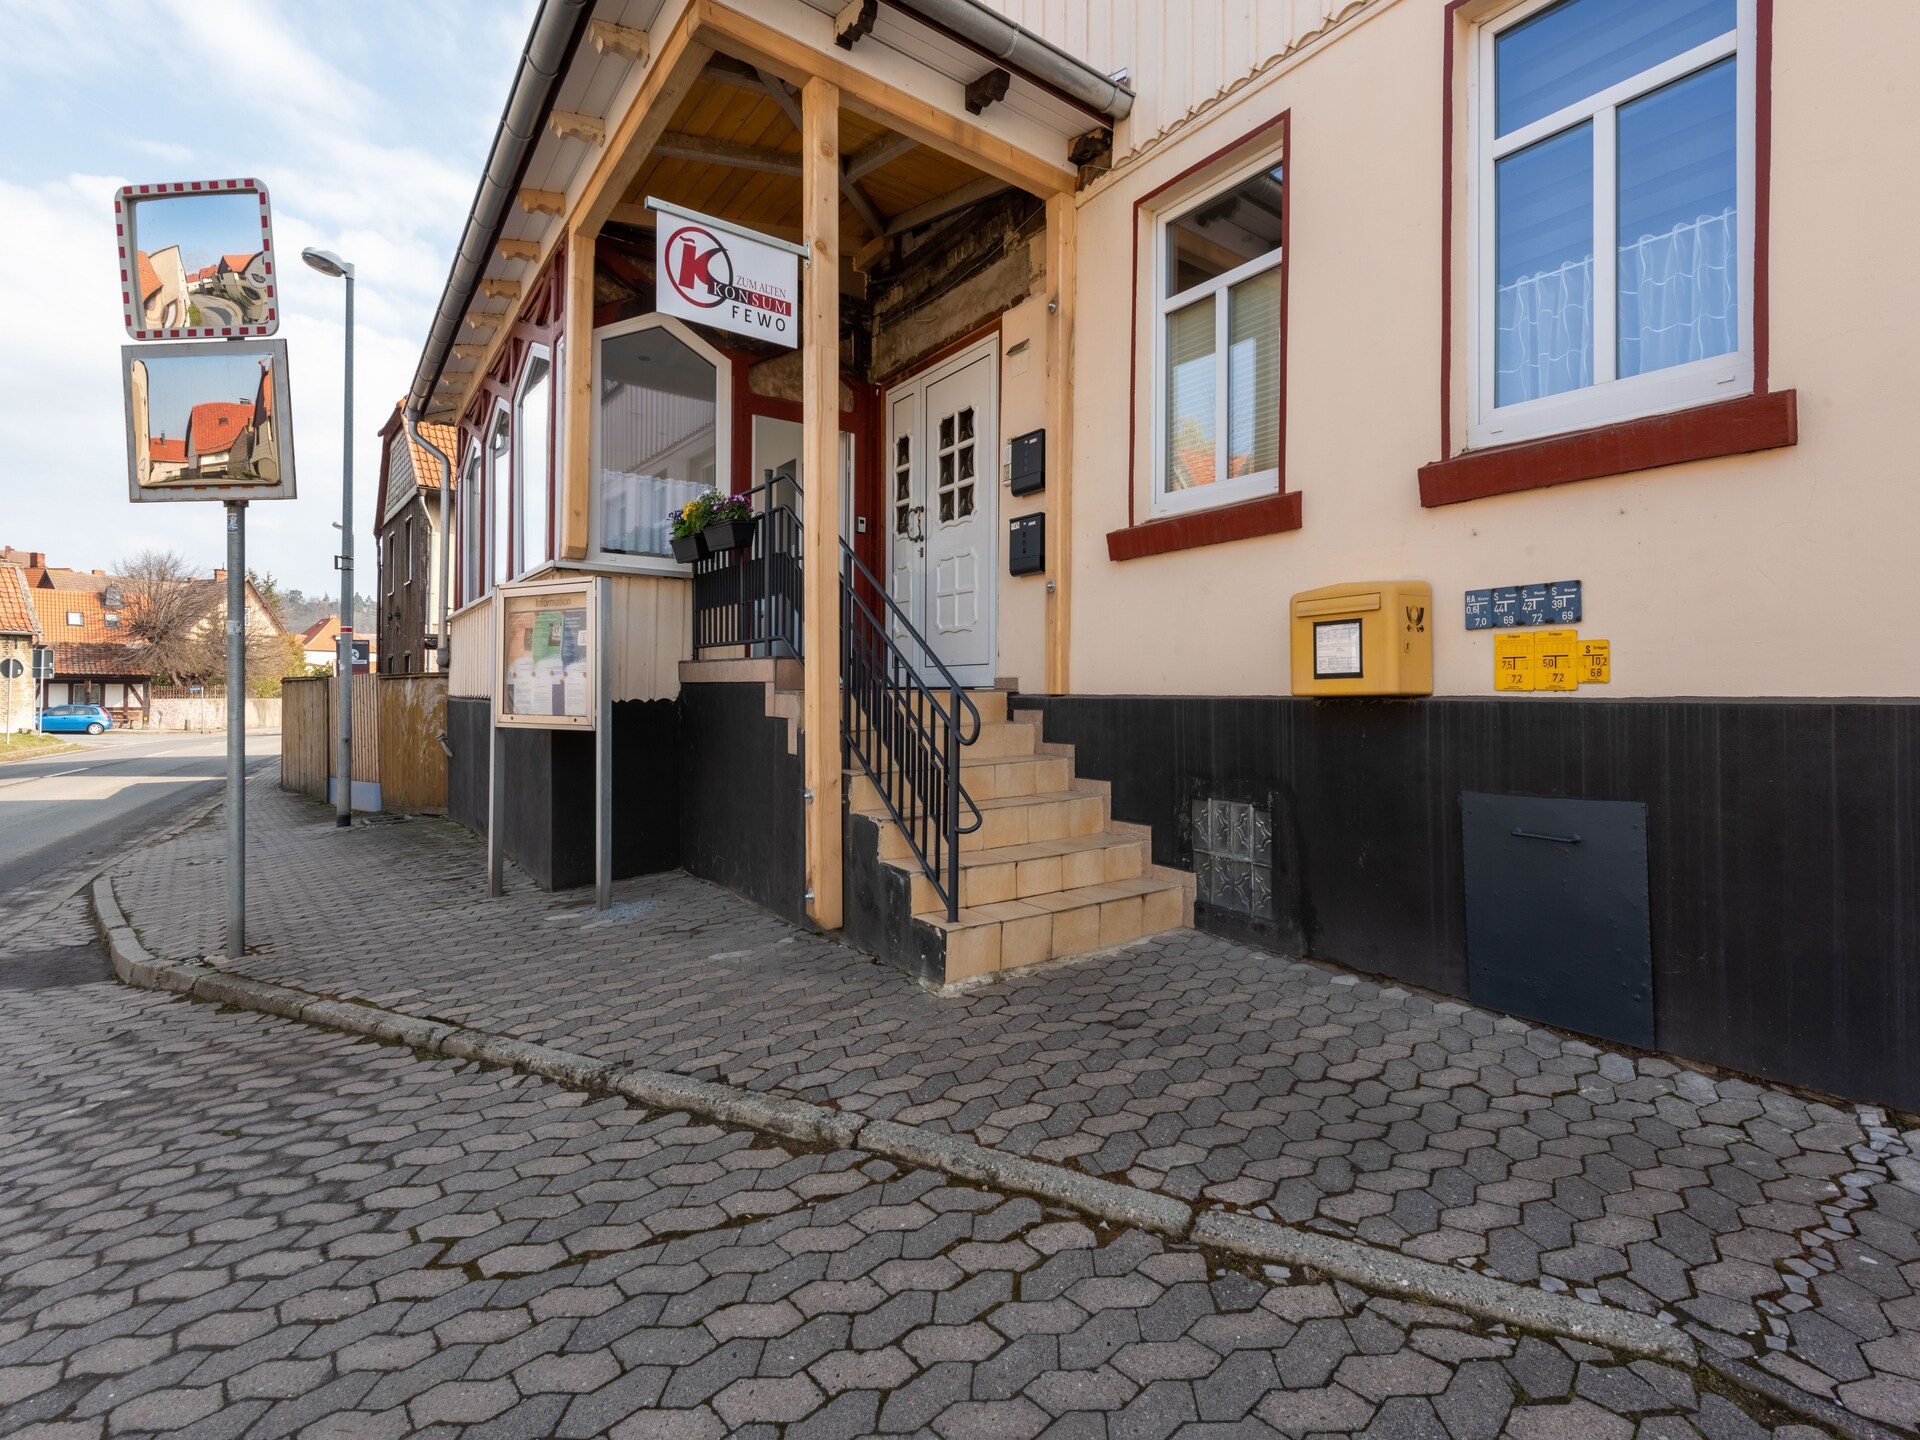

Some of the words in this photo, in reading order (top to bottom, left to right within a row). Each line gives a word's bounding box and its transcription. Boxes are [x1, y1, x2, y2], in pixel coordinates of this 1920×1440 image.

[736, 275, 757, 290] ZUM
[759, 281, 787, 299] ALTEN
[713, 282, 787, 315] KONSUM
[732, 305, 786, 332] FEWO
[1522, 590, 1528, 599] S
[1551, 586, 1557, 596] S
[1466, 595, 1476, 604] HA
[1493, 592, 1499, 601] S
[535, 597, 572, 607] Information
[1585, 645, 1591, 654] S
